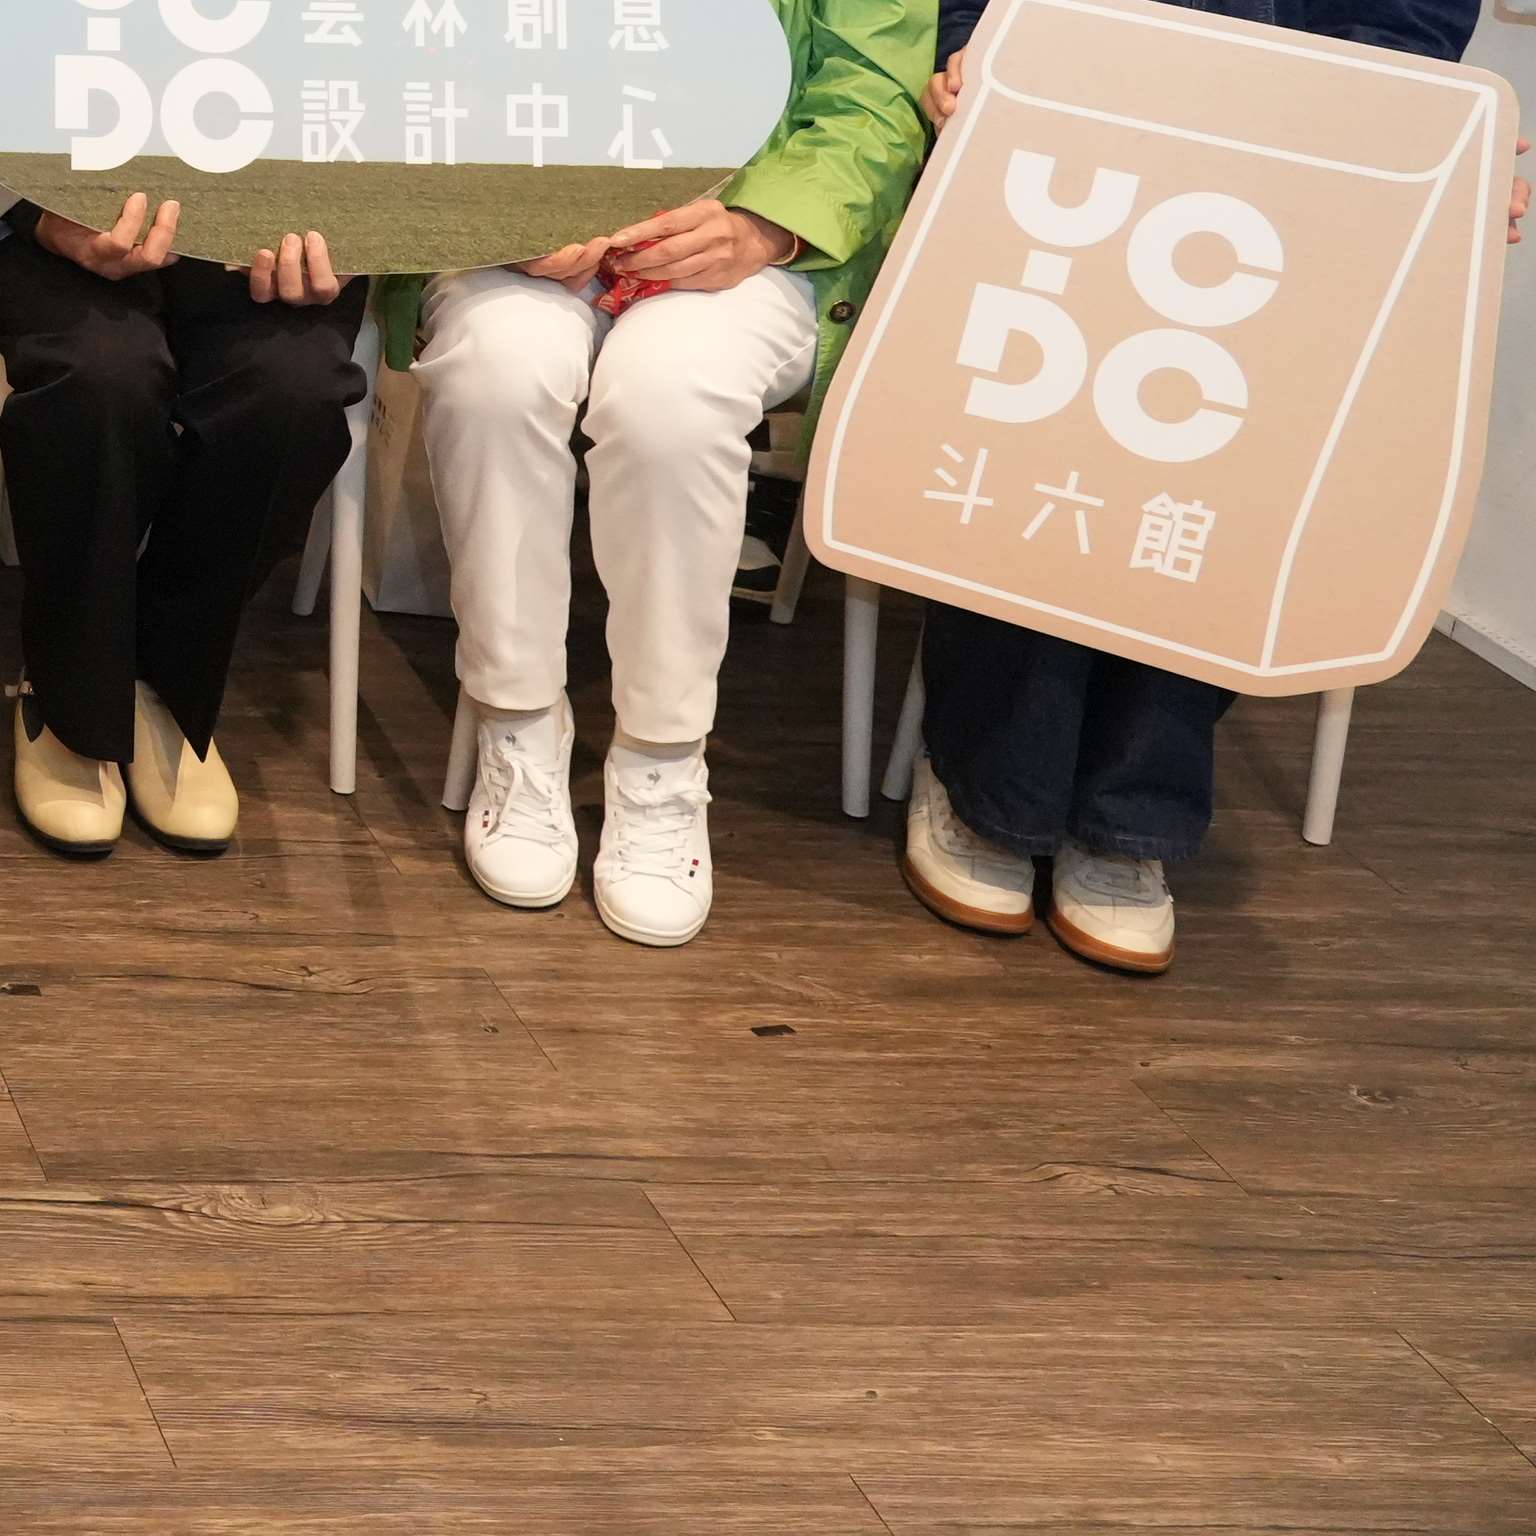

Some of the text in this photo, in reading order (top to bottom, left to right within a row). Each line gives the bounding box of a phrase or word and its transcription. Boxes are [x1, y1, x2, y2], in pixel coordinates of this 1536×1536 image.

[300, 78, 674, 170] 設計中心
[923, 442, 1217, 584] 斗六館
